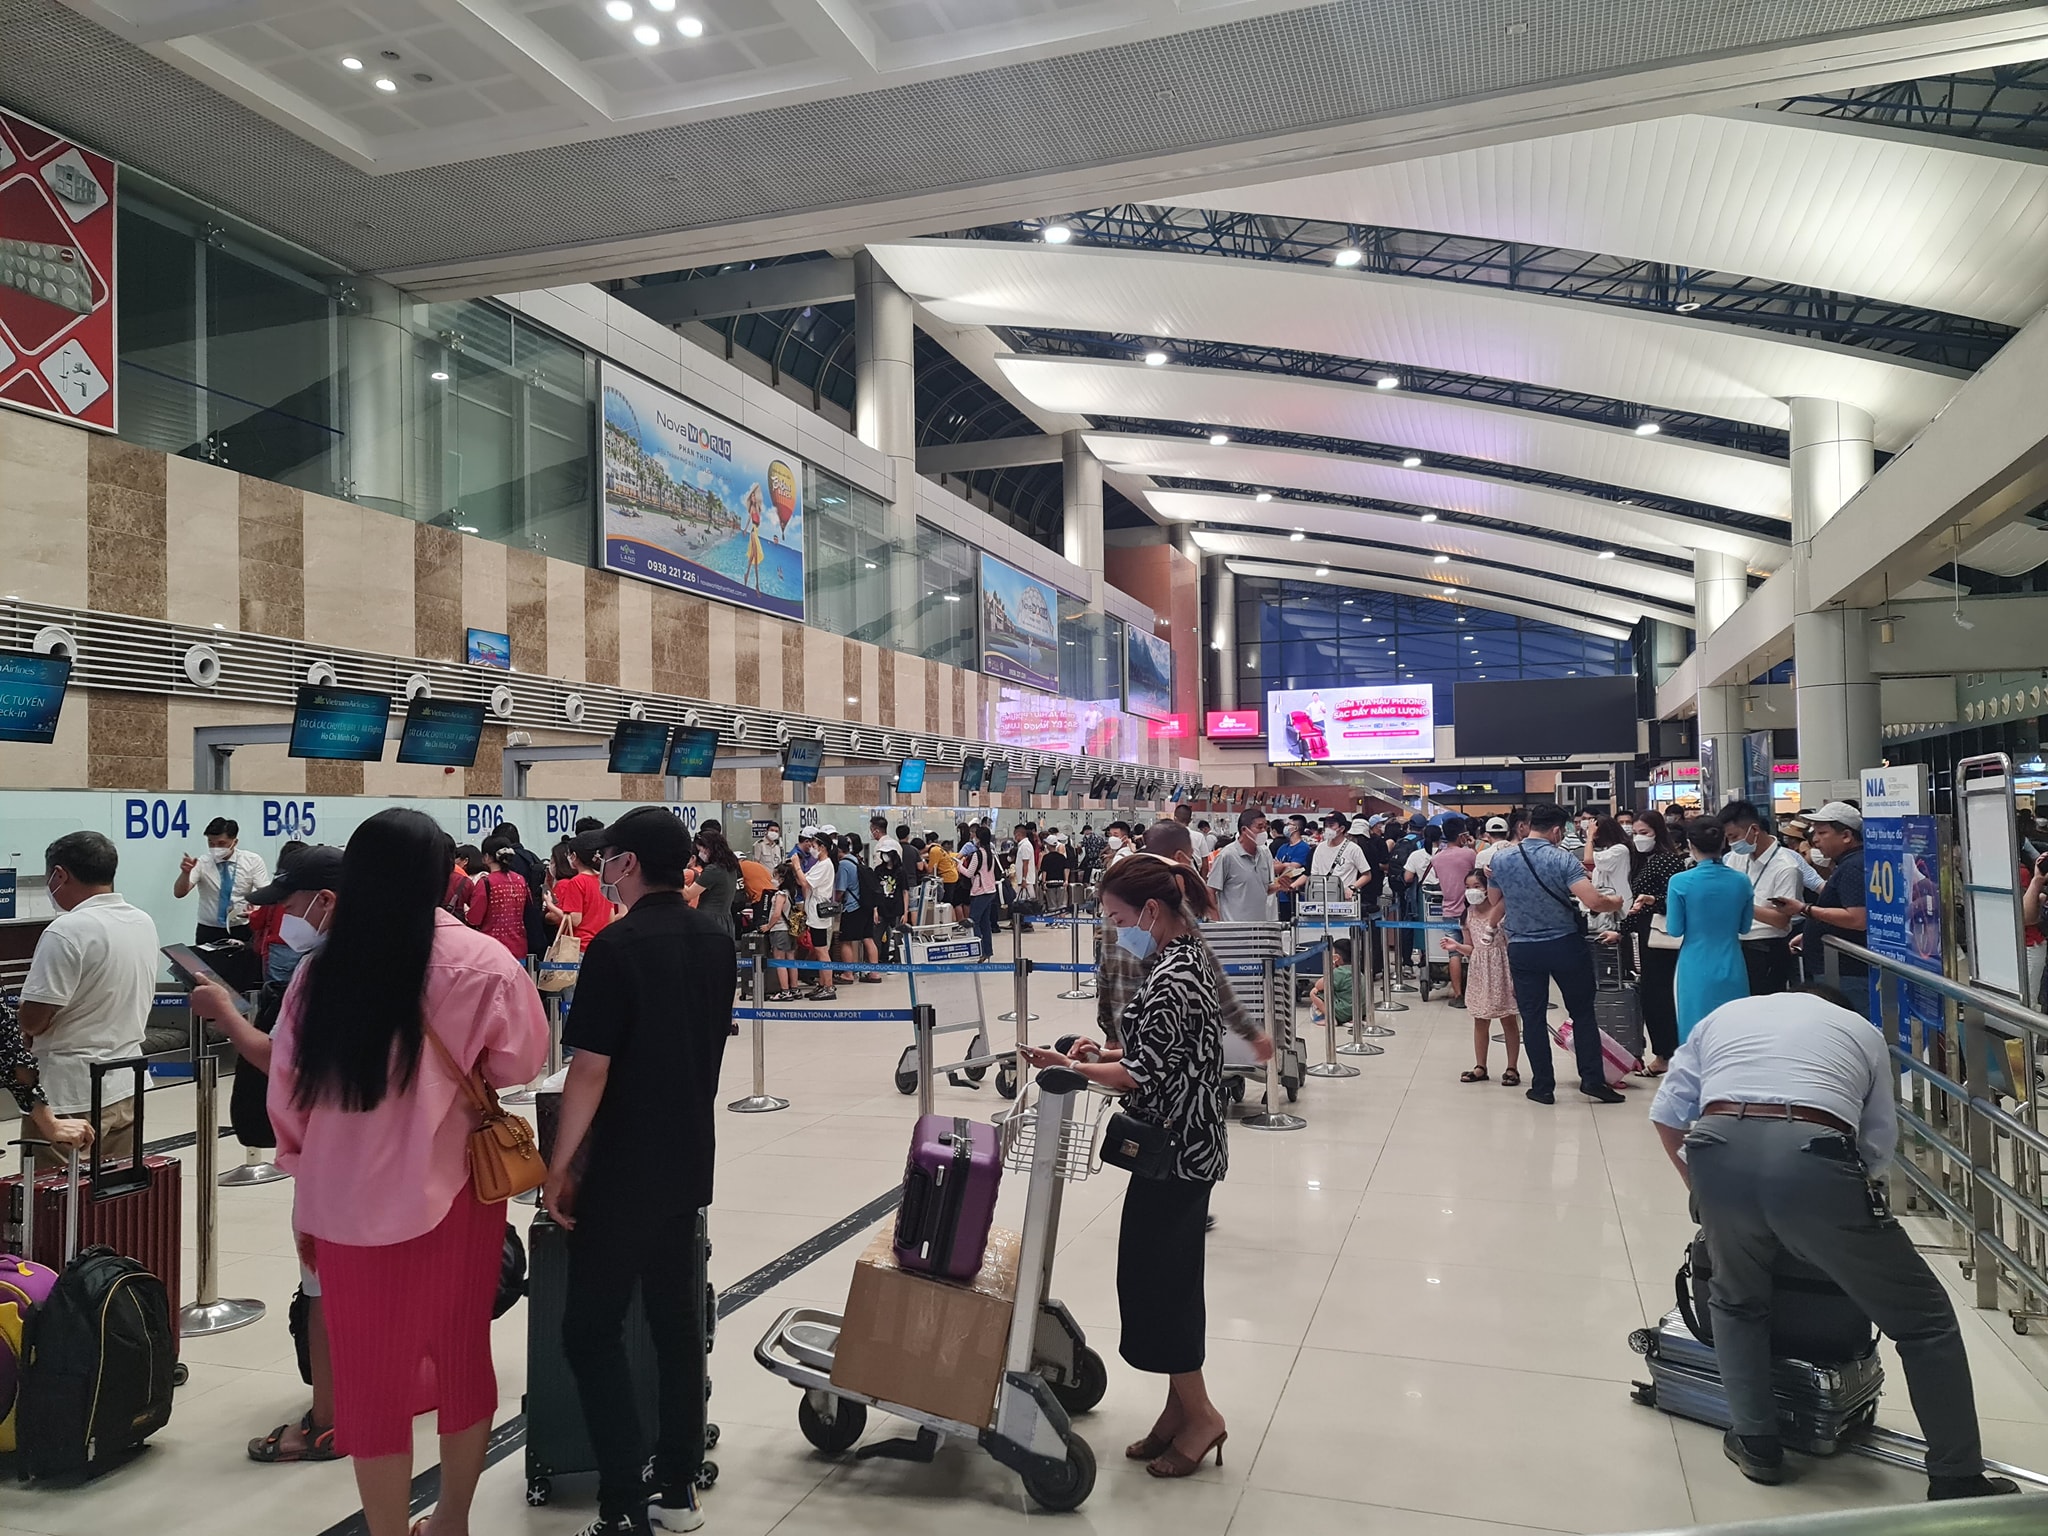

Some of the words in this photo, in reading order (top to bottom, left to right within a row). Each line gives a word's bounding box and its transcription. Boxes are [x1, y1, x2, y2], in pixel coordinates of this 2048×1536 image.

[647, 559, 667, 574] 0938
[668, 565, 681, 578] 221
[682, 570, 696, 583] 226
[0, 663, 36, 676] Airlines
[1866, 777, 1886, 797] NIA
[125, 799, 190, 840] B04
[263, 800, 316, 837] B05
[467, 803, 504, 834] B06
[547, 804, 579, 833] B07
[800, 807, 818, 827] B09
[1869, 859, 1894, 904] 40
[161, 998, 183, 1006] AIRPORT
[756, 1010, 779, 1019] NOIBAI
[780, 1010, 832, 1019] INTERNATIONAL
[833, 1011, 862, 1019] AIRPORT
[878, 1011, 895, 1019] N.I.A
